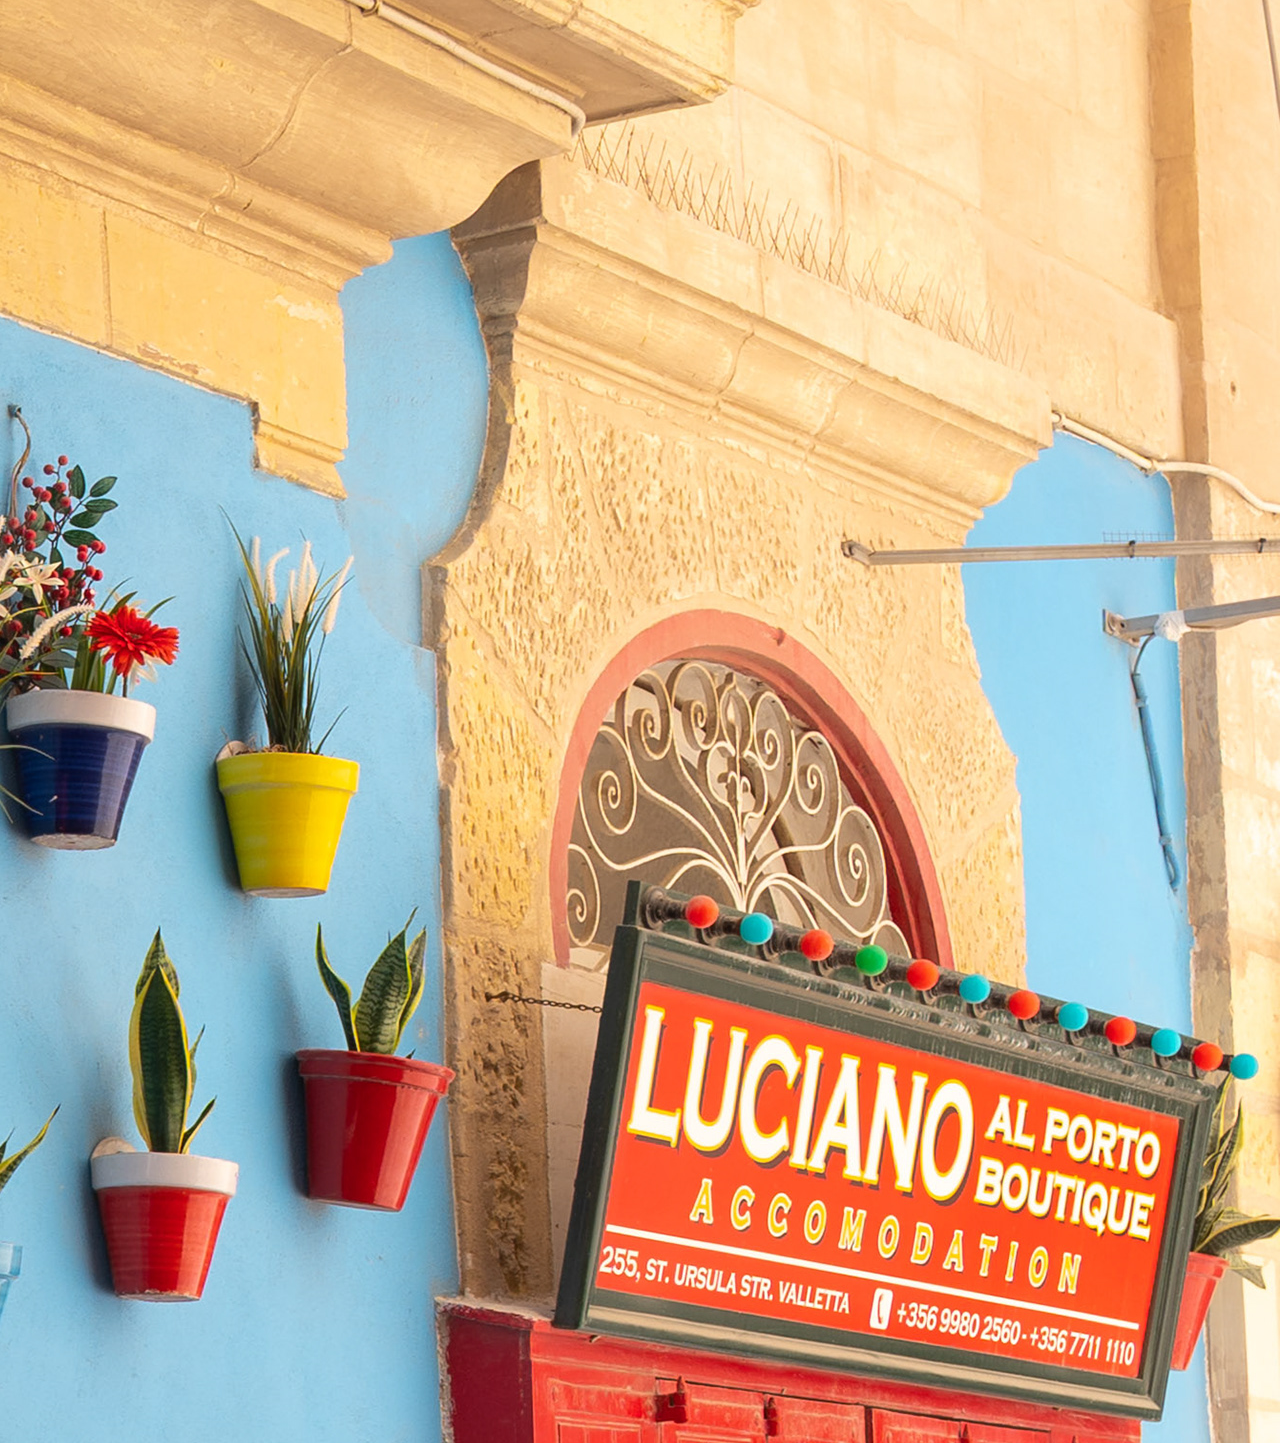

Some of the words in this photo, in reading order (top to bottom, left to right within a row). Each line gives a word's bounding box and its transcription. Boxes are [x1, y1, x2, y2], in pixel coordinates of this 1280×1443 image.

[627, 1004, 974, 1202] LUCIANO
[984, 1094, 1035, 1152] AL
[1042, 1106, 1161, 1178] PORTO
[689, 1178, 1082, 1294] ACCOMODATION
[974, 1156, 1156, 1242] BOUTIQUE
[599, 1246, 641, 1283] 255,
[645, 1258, 670, 1285] ST.
[674, 1263, 737, 1295] URSULA
[740, 1274, 774, 1301] STR.
[778, 1280, 850, 1314] VALLETTA
[897, 1302, 939, 1331] +356
[939, 1308, 980, 1337] 9980
[1030, 1326, 1068, 1354] +356
[1069, 1331, 1101, 1360] 7711
[1105, 1338, 1136, 1366] 1110
